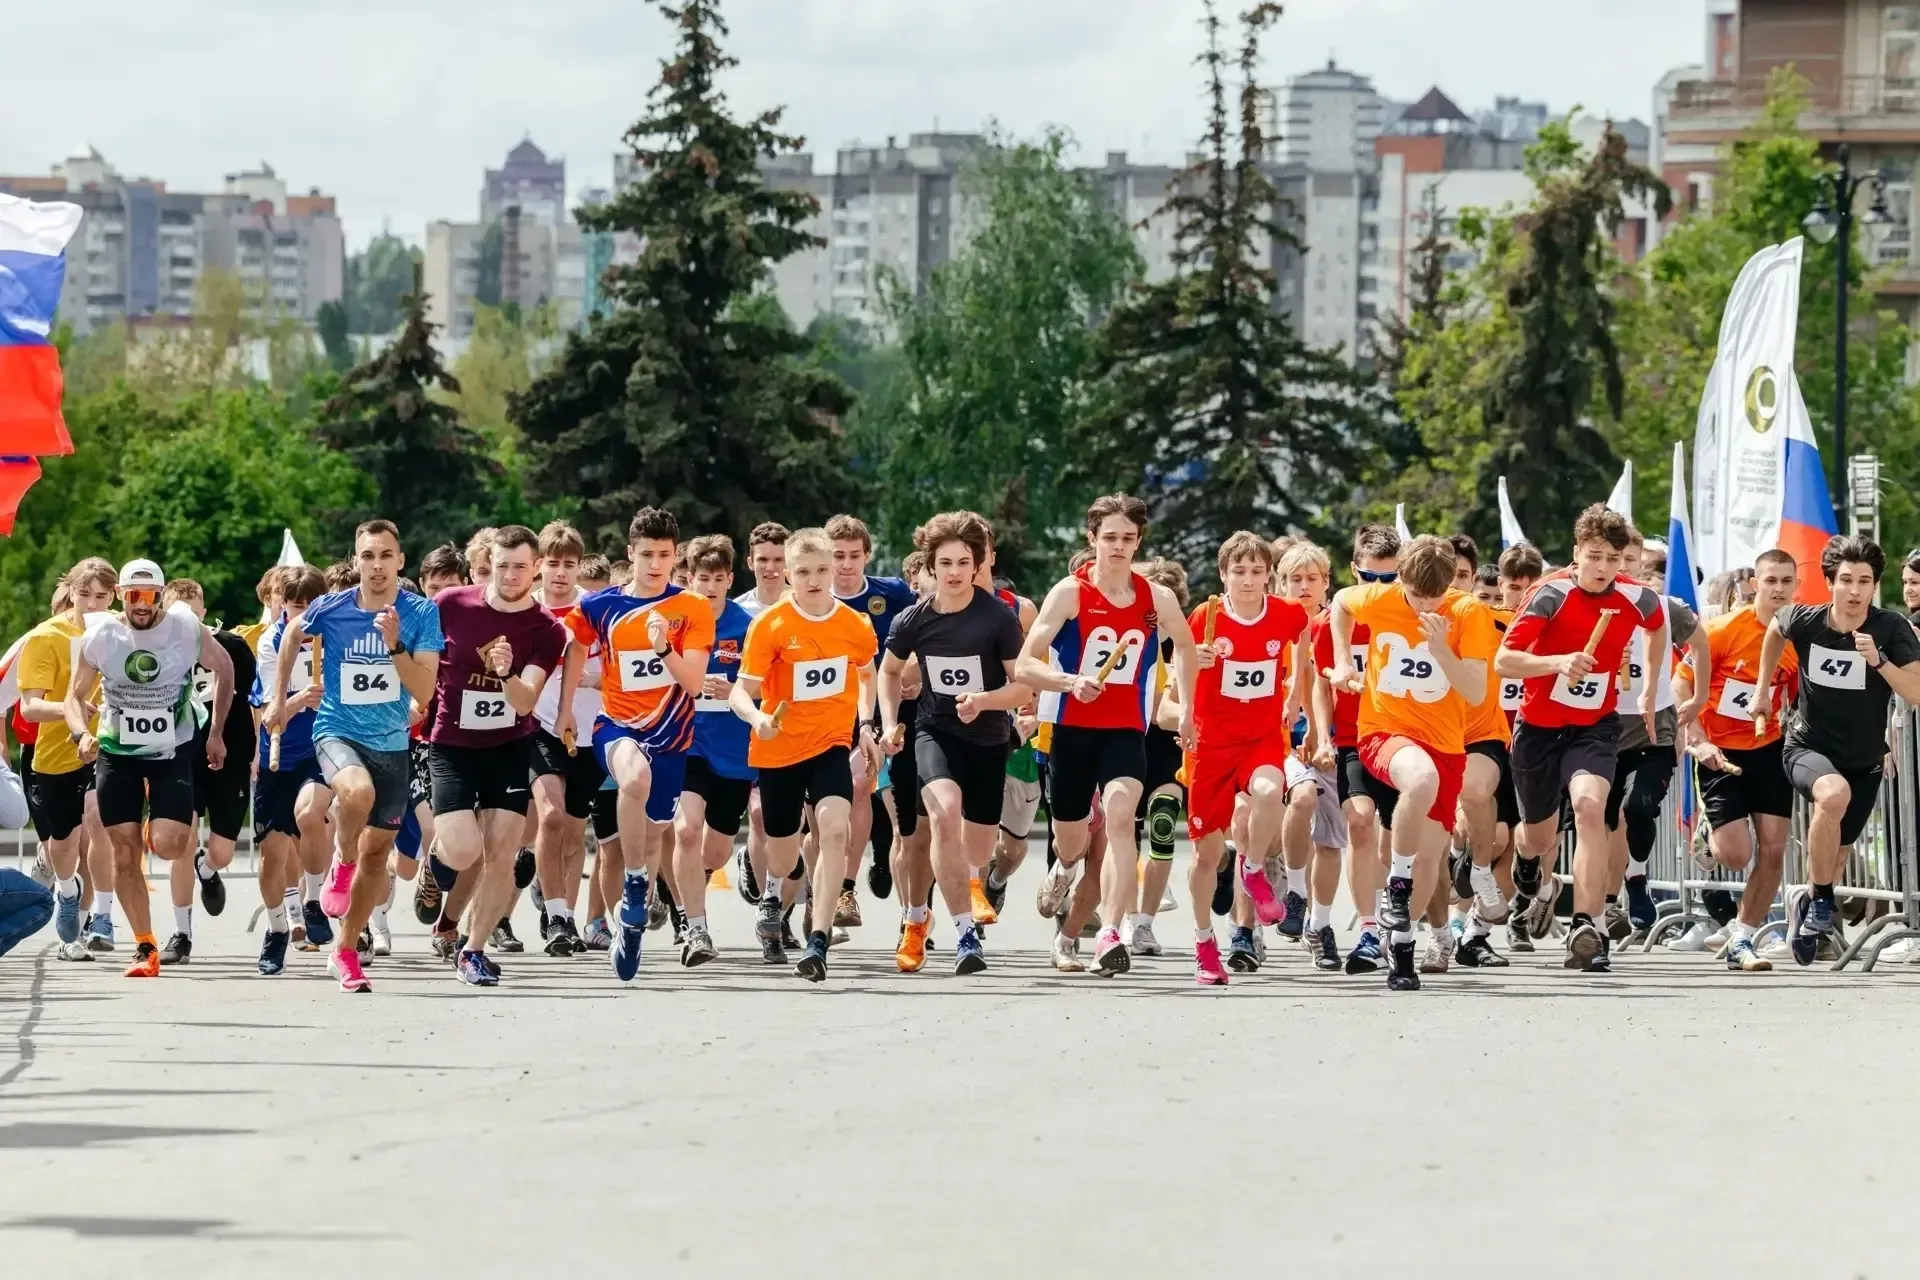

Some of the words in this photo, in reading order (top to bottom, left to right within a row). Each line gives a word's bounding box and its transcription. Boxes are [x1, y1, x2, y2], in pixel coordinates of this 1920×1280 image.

[631, 658, 664, 677] 26
[1095, 651, 1127, 670] 20
[1353, 655, 1368, 672] 1
[1400, 658, 1432, 678] 29
[1820, 658, 1852, 677] 47
[352, 673, 389, 691] 84
[468, 673, 500, 689] ЛГТ
[805, 667, 836, 687] 90
[940, 669, 970, 686] 69
[1234, 670, 1265, 687] 30
[1568, 680, 1598, 698] 65
[1732, 691, 1753, 708] 4
[474, 700, 505, 717] 82
[125, 717, 168, 734] 100
